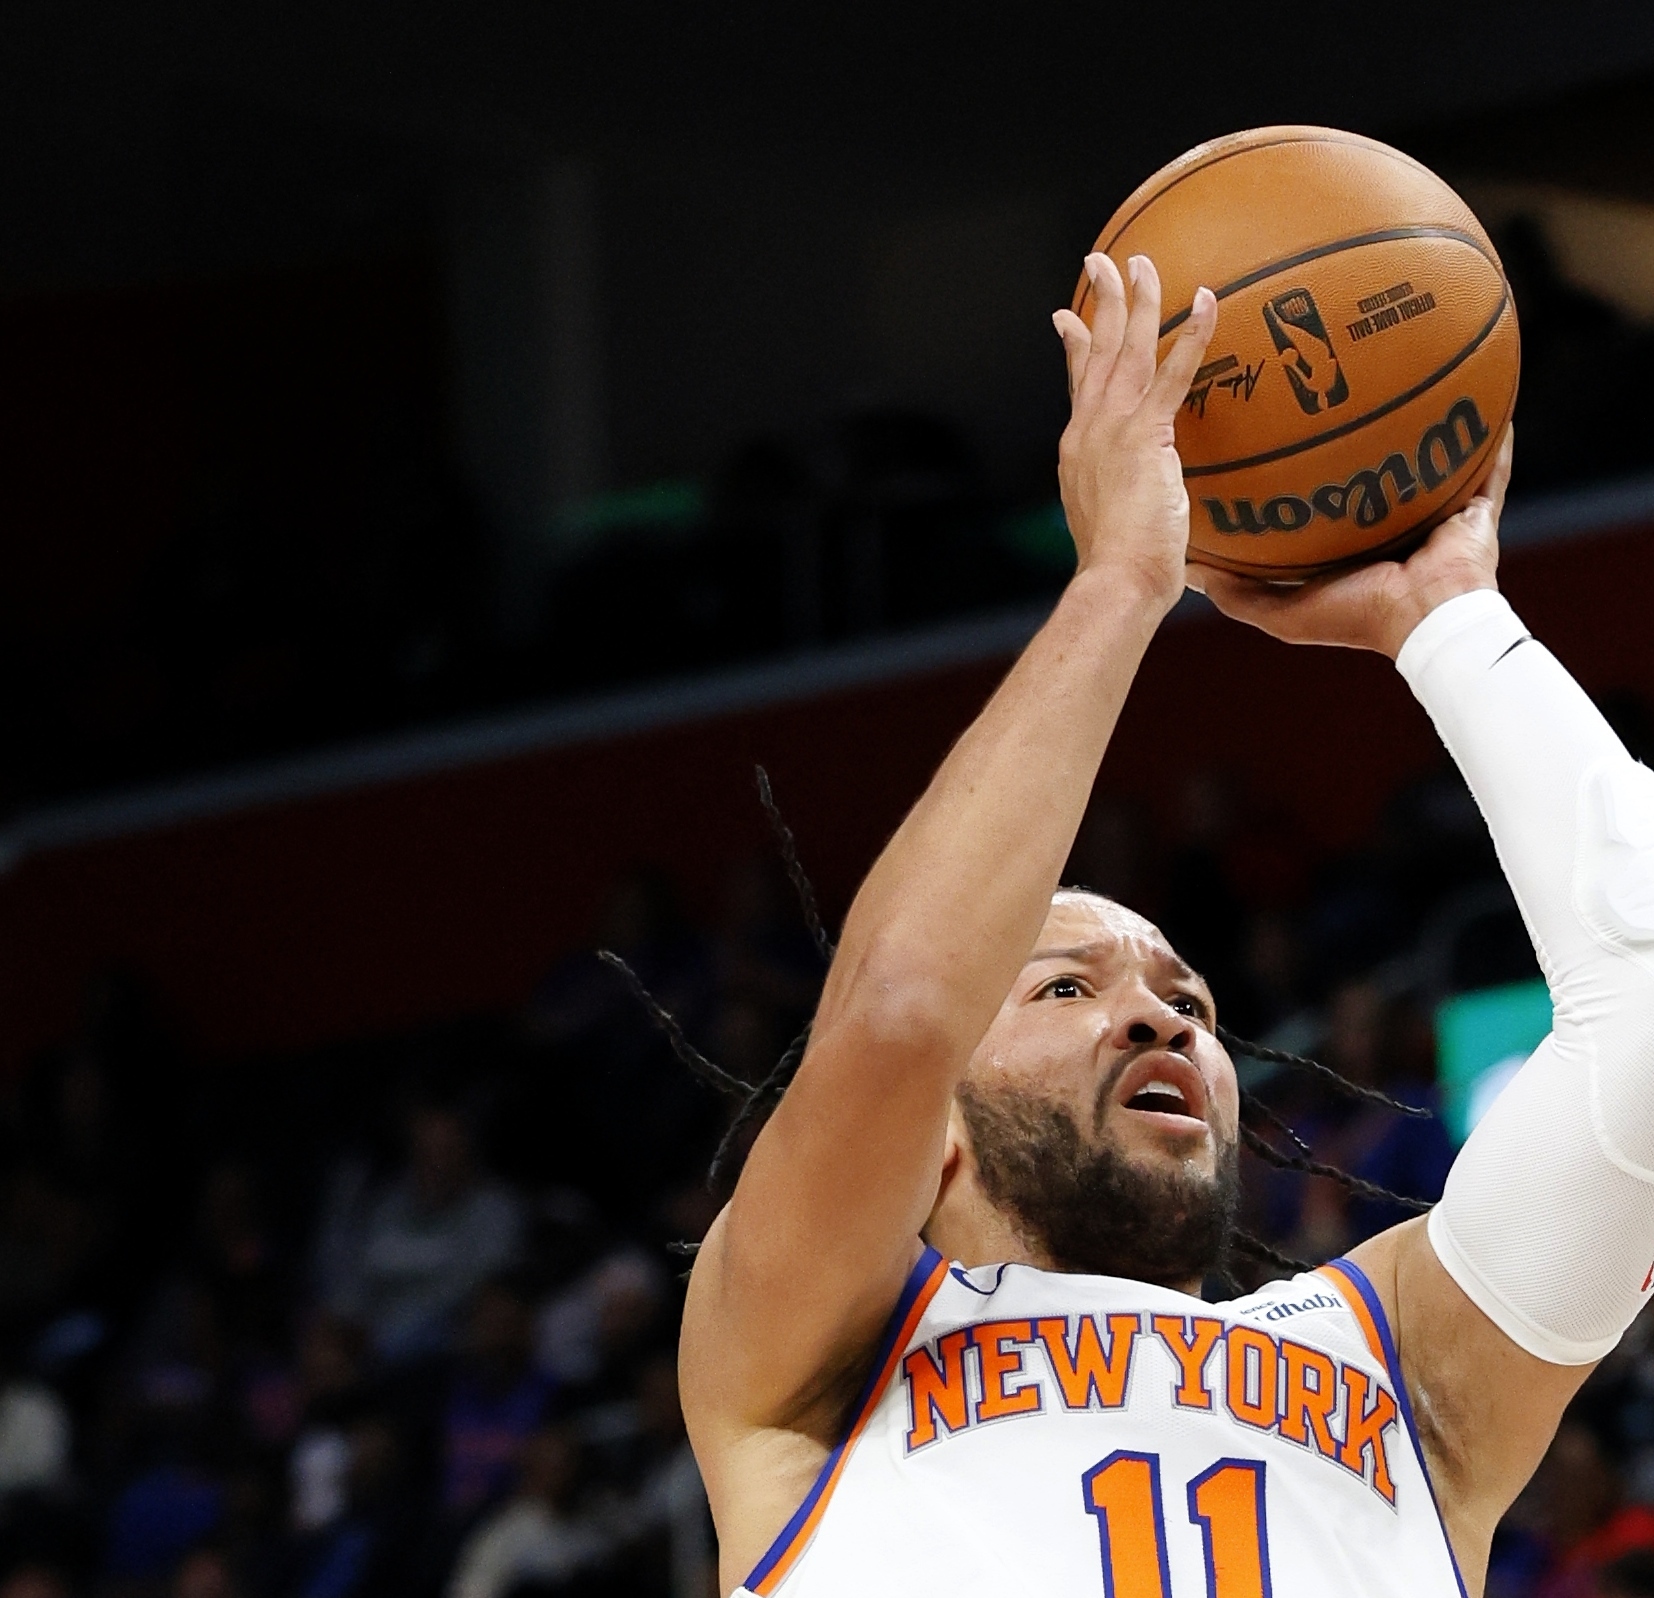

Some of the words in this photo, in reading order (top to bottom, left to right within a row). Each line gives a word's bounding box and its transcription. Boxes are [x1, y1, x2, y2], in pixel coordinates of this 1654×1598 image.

[1200, 396, 1490, 536] Wilson
[1266, 1293, 1343, 1321] dhabi
[902, 1312, 1142, 1457] NEW
[1150, 1311, 1399, 1512] YORK
